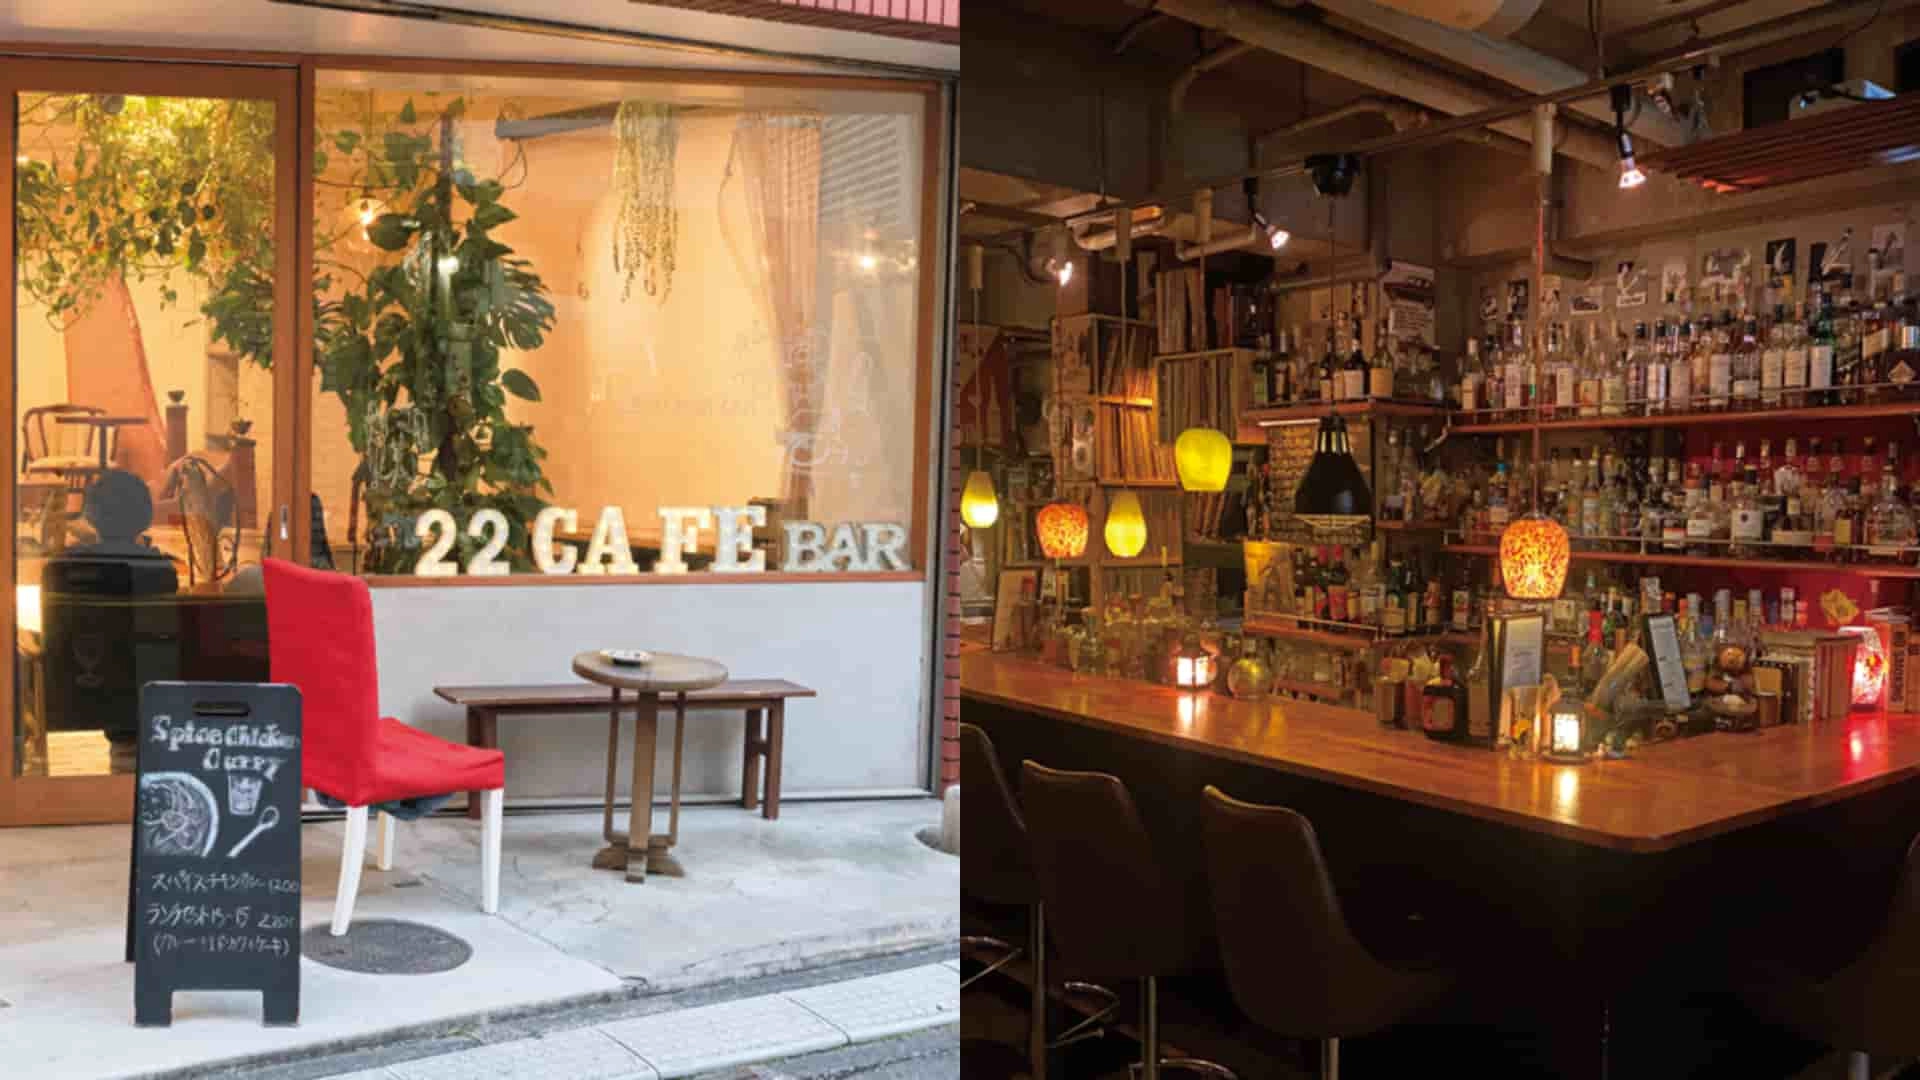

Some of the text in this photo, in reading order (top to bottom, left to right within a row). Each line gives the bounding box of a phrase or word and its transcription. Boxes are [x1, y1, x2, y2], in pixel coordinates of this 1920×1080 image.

[415, 504, 911, 577] 22 CAFE BAR
[150, 714, 223, 752] Spice
